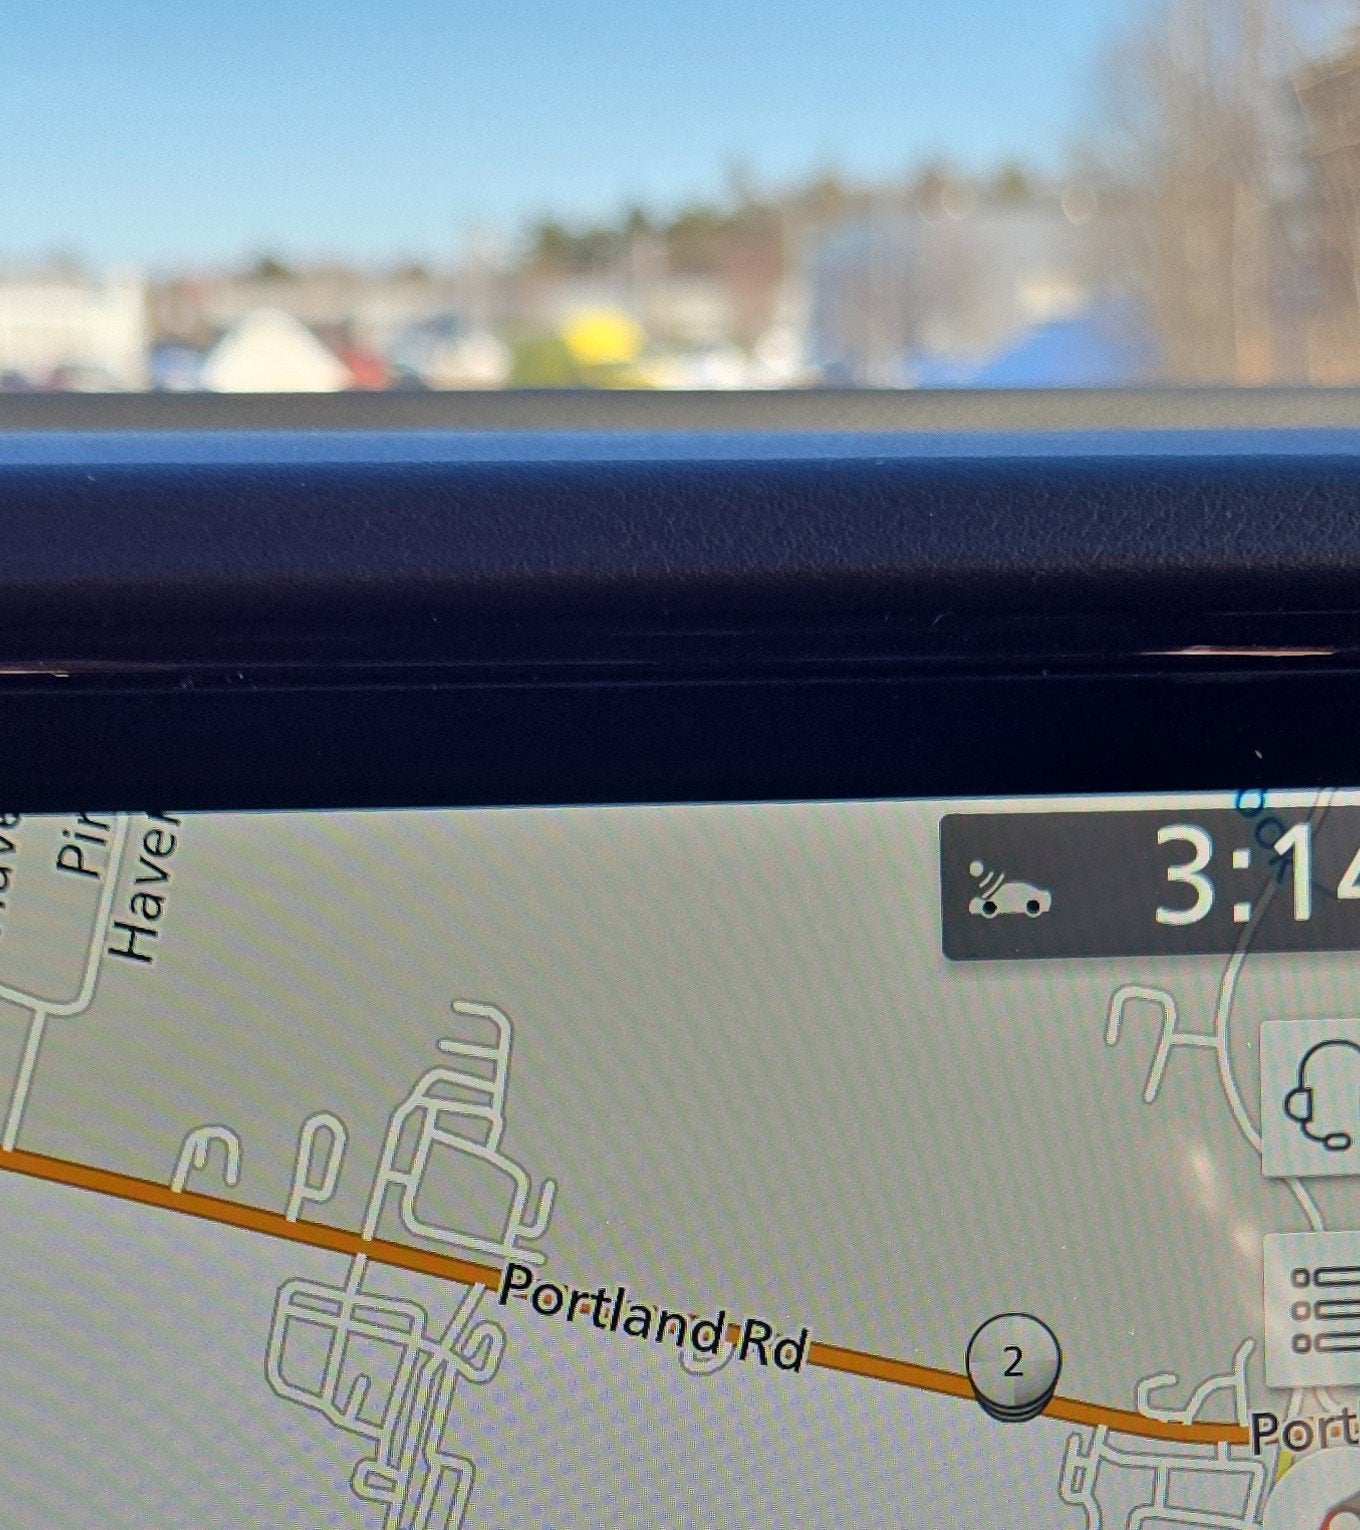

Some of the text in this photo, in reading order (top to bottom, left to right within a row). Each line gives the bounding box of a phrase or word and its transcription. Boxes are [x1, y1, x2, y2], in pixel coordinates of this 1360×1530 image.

[499, 1262, 810, 1372] Portland Rd
[1003, 1345, 1024, 1377] 2
